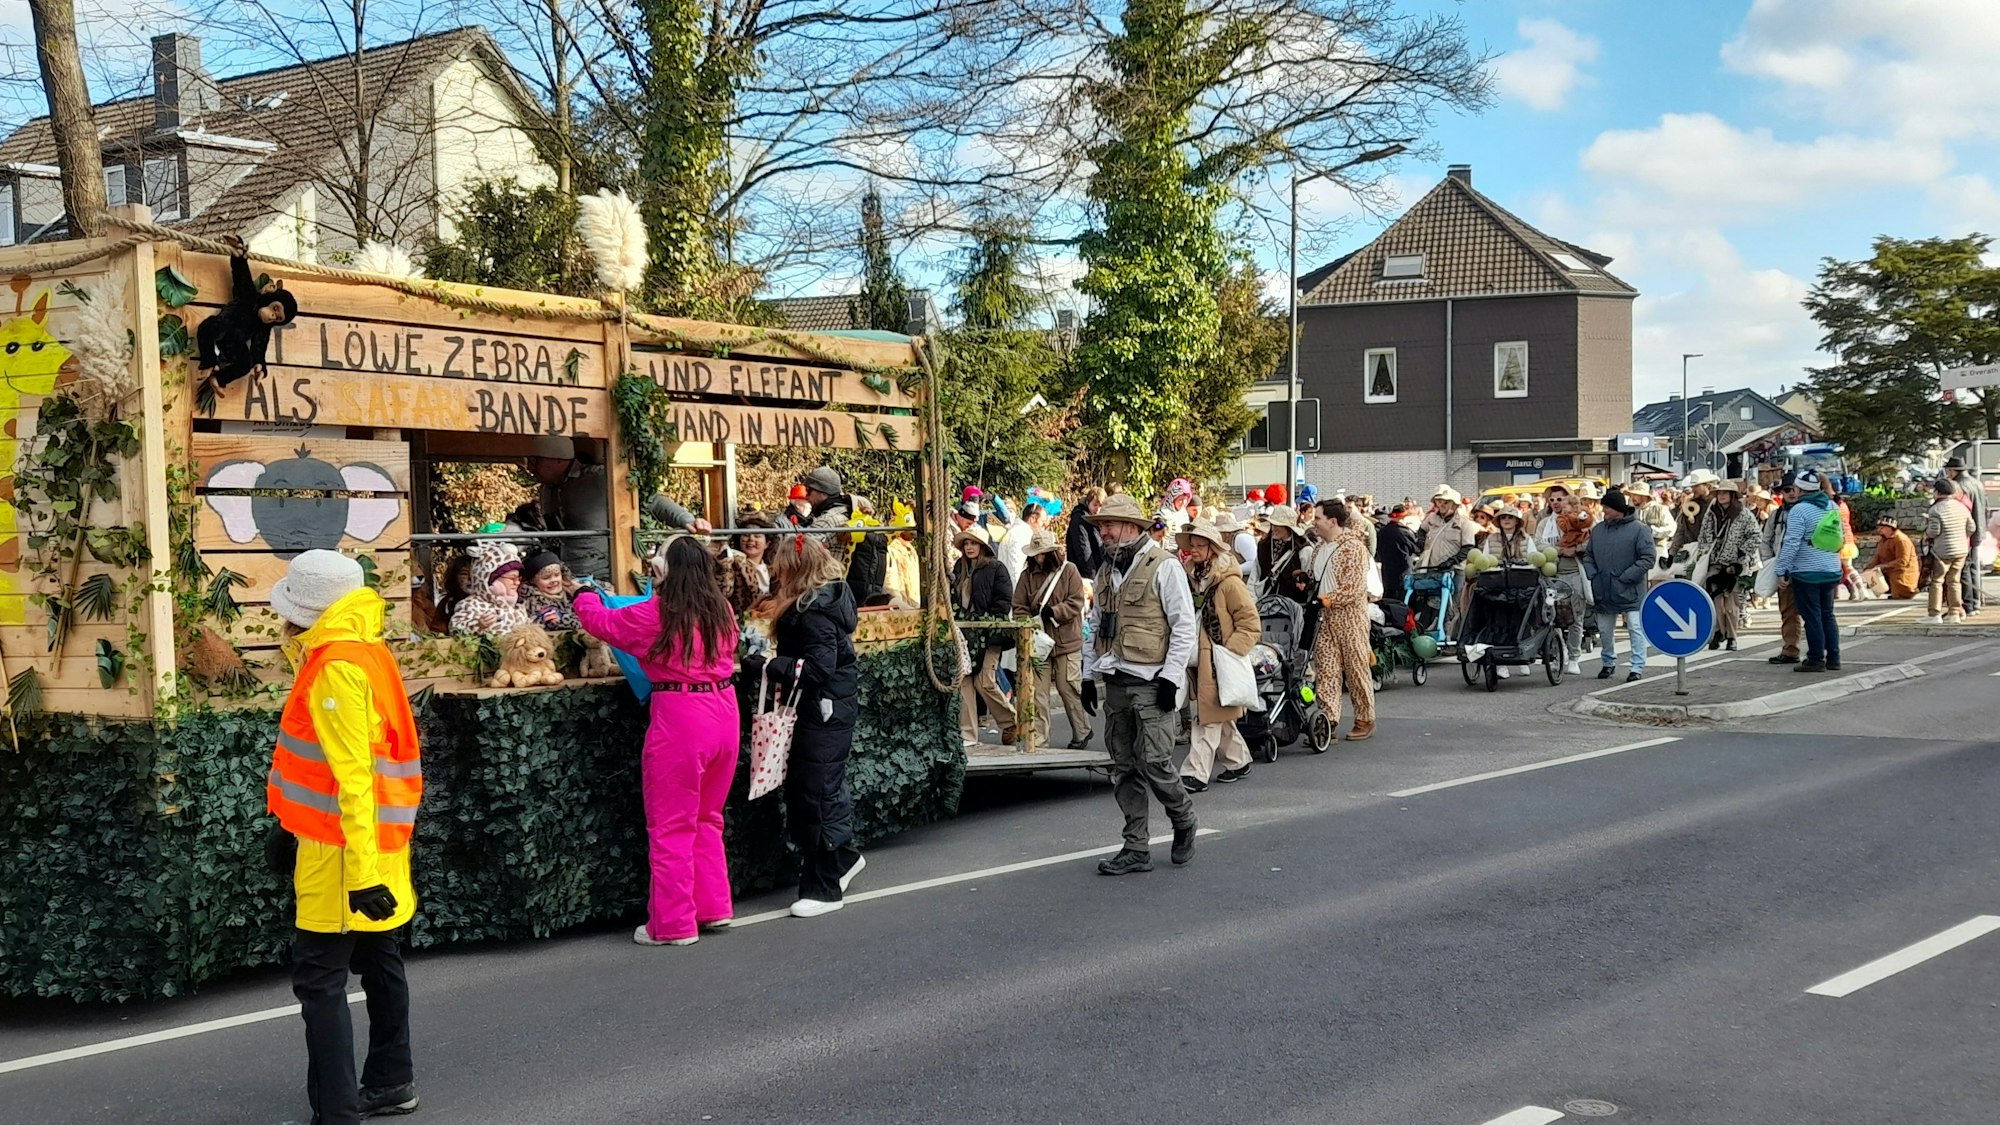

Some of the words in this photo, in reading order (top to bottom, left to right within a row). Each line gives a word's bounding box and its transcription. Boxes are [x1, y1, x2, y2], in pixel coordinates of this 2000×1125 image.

[320, 322, 432, 375] LÖWE,
[244, 373, 318, 424] ALS
[650, 359, 712, 393] UND
[730, 365, 842, 402] ELEFANT
[739, 412, 763, 445] IN
[775, 412, 836, 449] HAND
[1505, 459, 1533, 468] Allianz
